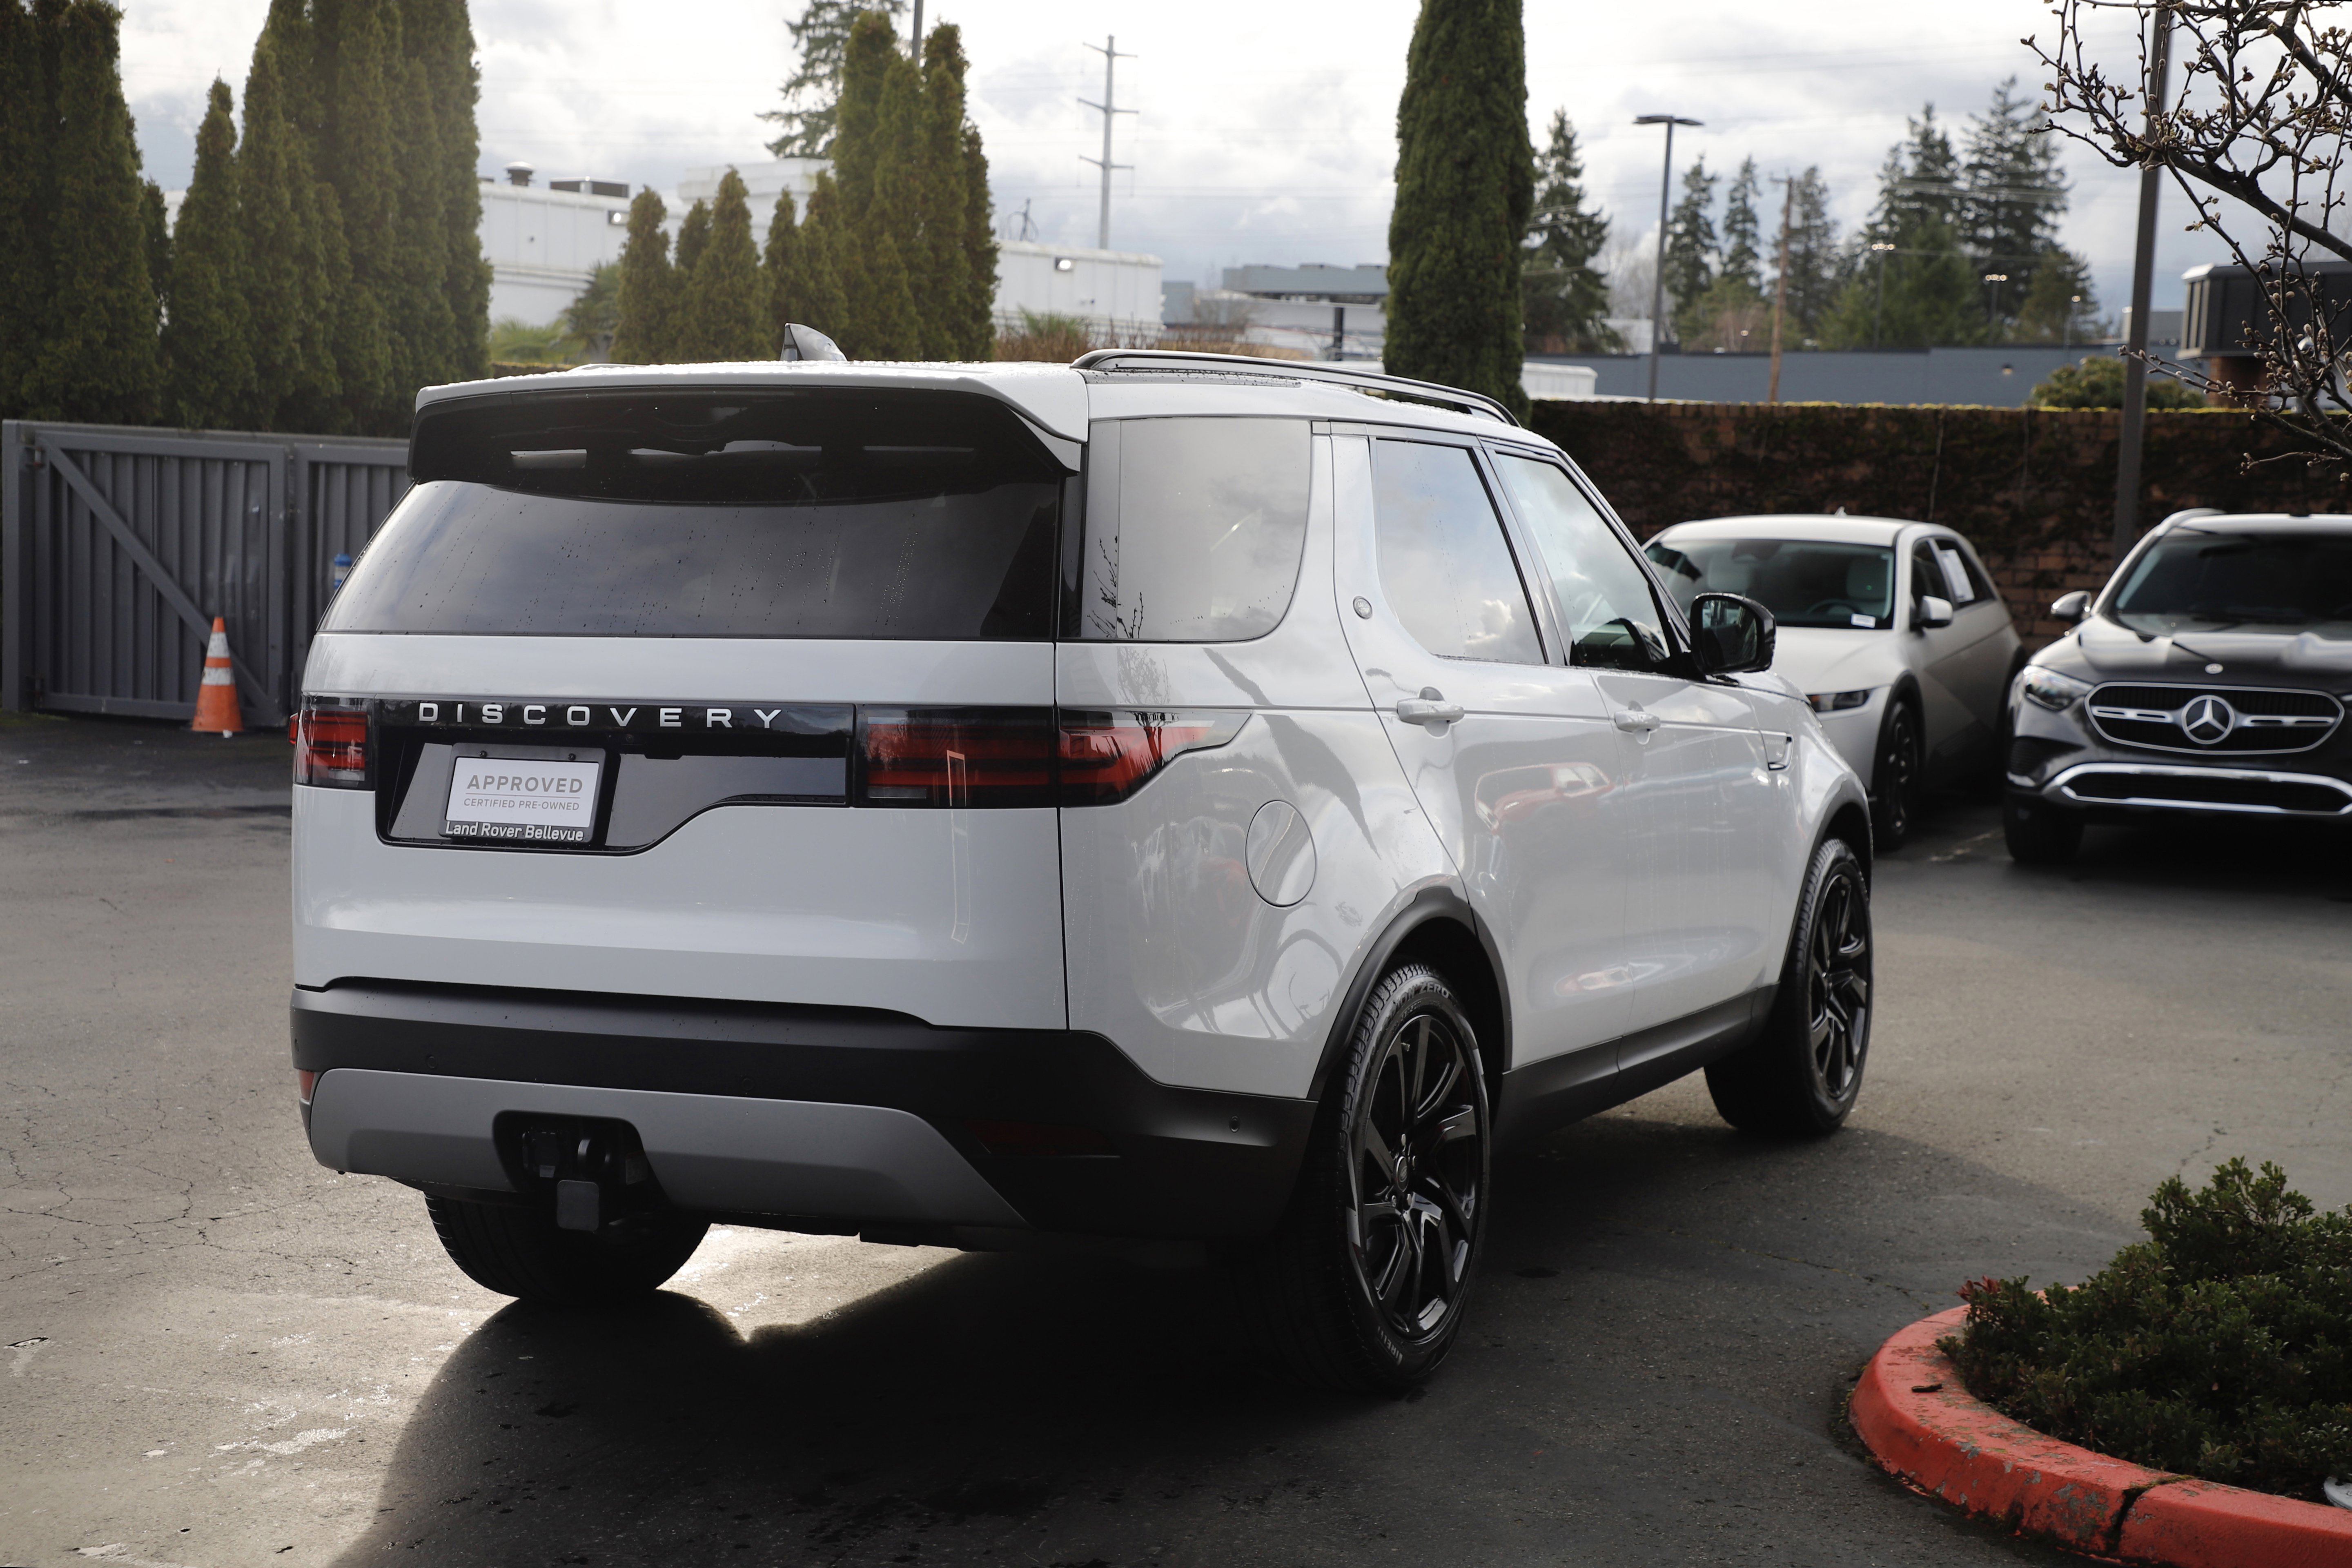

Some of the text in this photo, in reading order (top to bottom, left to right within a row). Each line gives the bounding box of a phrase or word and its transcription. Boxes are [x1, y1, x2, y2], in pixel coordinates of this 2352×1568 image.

[419, 702, 782, 729] DISCOVERY
[466, 775, 583, 793] APPROVED
[463, 798, 579, 811] CERTIFIED PRE-OWNED
[445, 821, 584, 841] Land Rover Bellevue
[1419, 981, 1450, 999] ZERO
